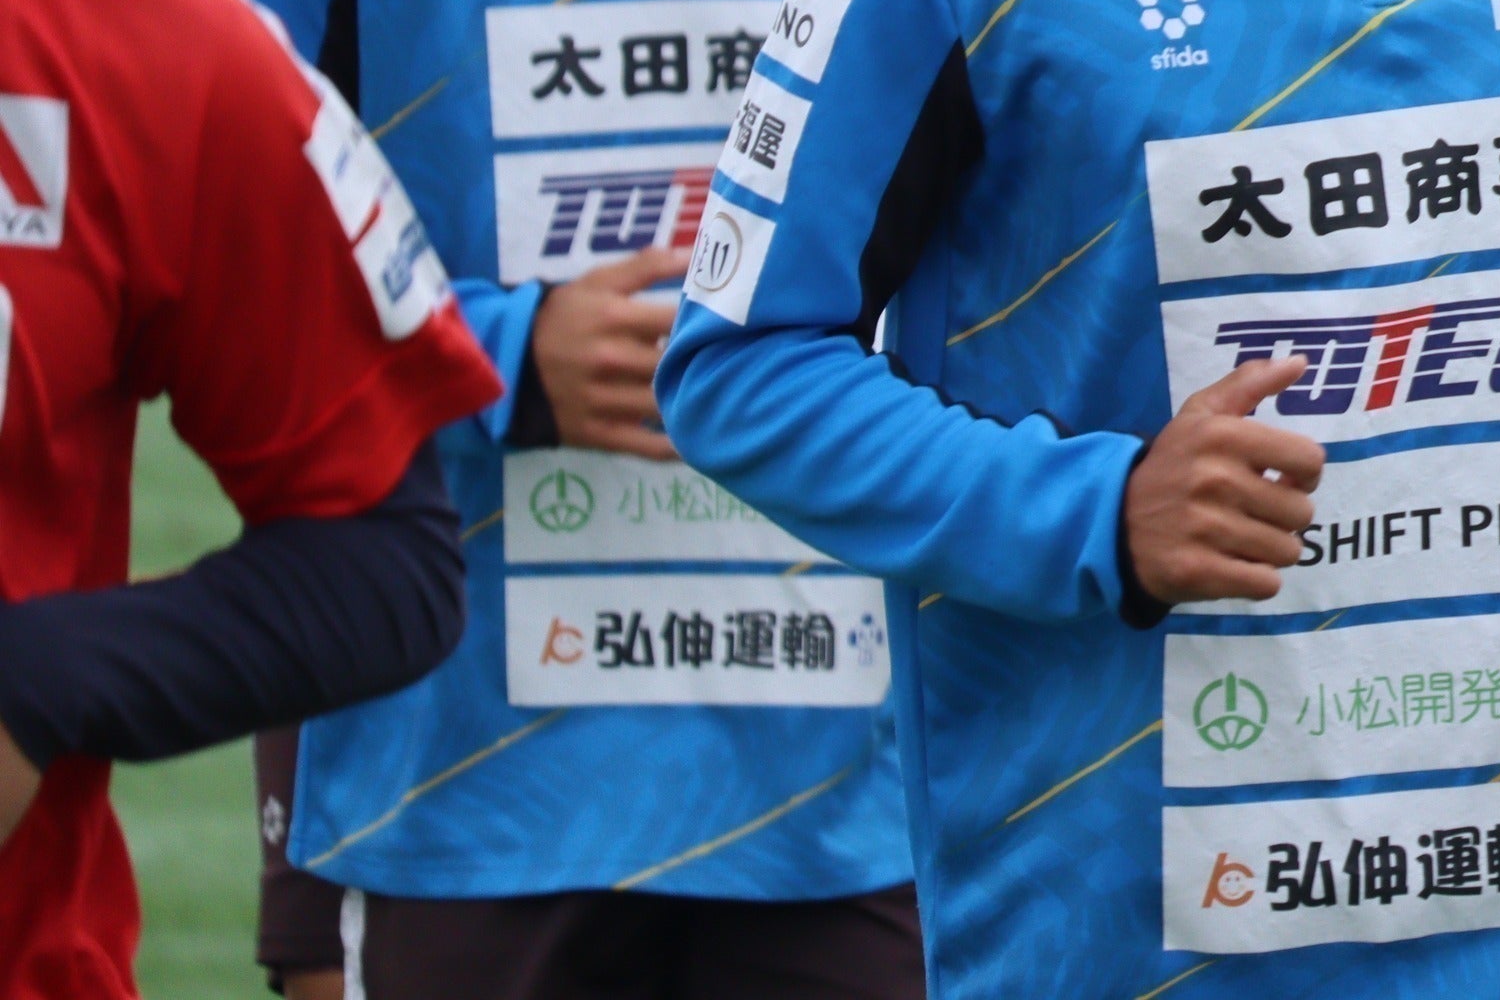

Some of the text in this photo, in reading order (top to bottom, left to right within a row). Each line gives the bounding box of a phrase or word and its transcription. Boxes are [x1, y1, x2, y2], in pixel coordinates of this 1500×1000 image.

[1150, 45, 1209, 71] sfida
[1295, 507, 1441, 567] SHIFT
[594, 608, 837, 671] 弘伸運輸
